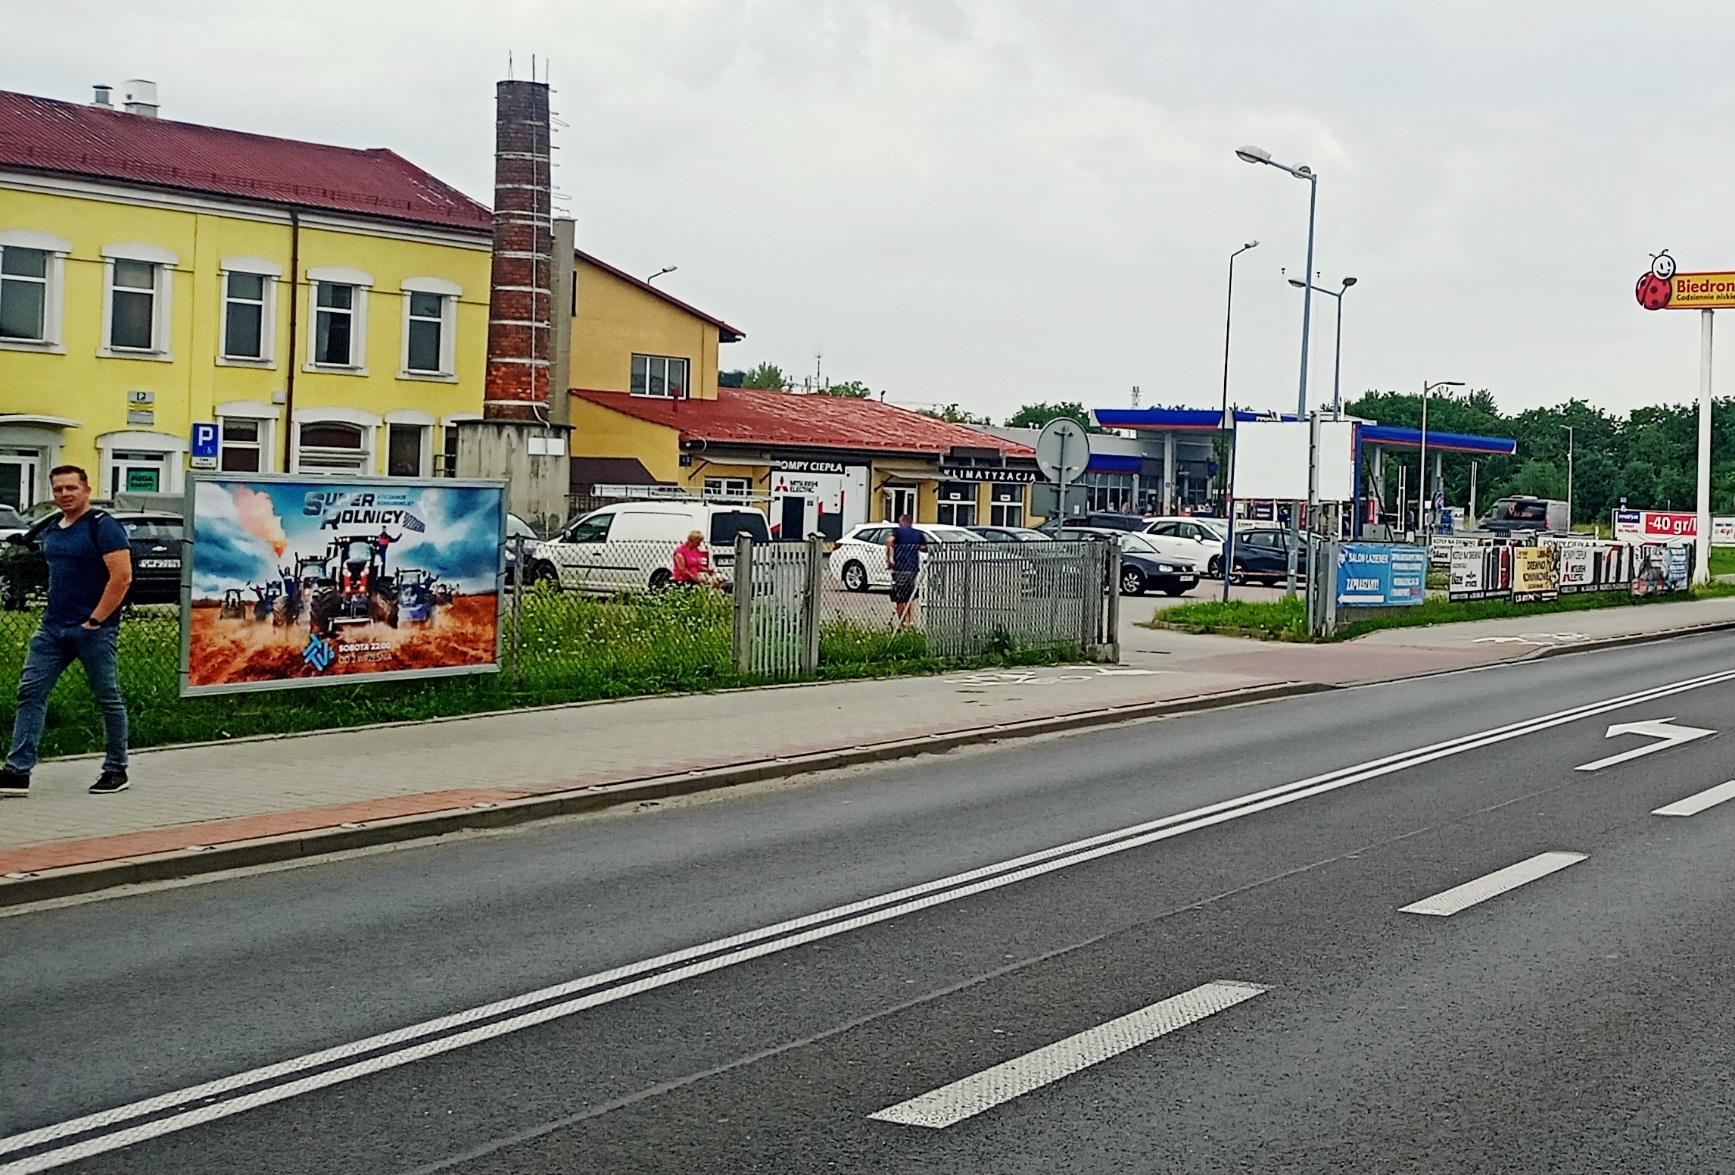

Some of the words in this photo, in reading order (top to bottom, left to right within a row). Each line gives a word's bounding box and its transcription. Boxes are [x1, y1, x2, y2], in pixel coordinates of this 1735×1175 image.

[1677, 279, 1735, 293] Biedron
[199, 426, 214, 446] P
[810, 462, 843, 472] CIEPŁA
[943, 469, 1036, 482] KLIMATYZACJA
[303, 491, 376, 516] SUPER
[320, 510, 405, 530] ROLNICY
[1648, 516, 1671, 530] -40
[338, 643, 369, 651] SOBOTA
[370, 642, 391, 650] 22:00
